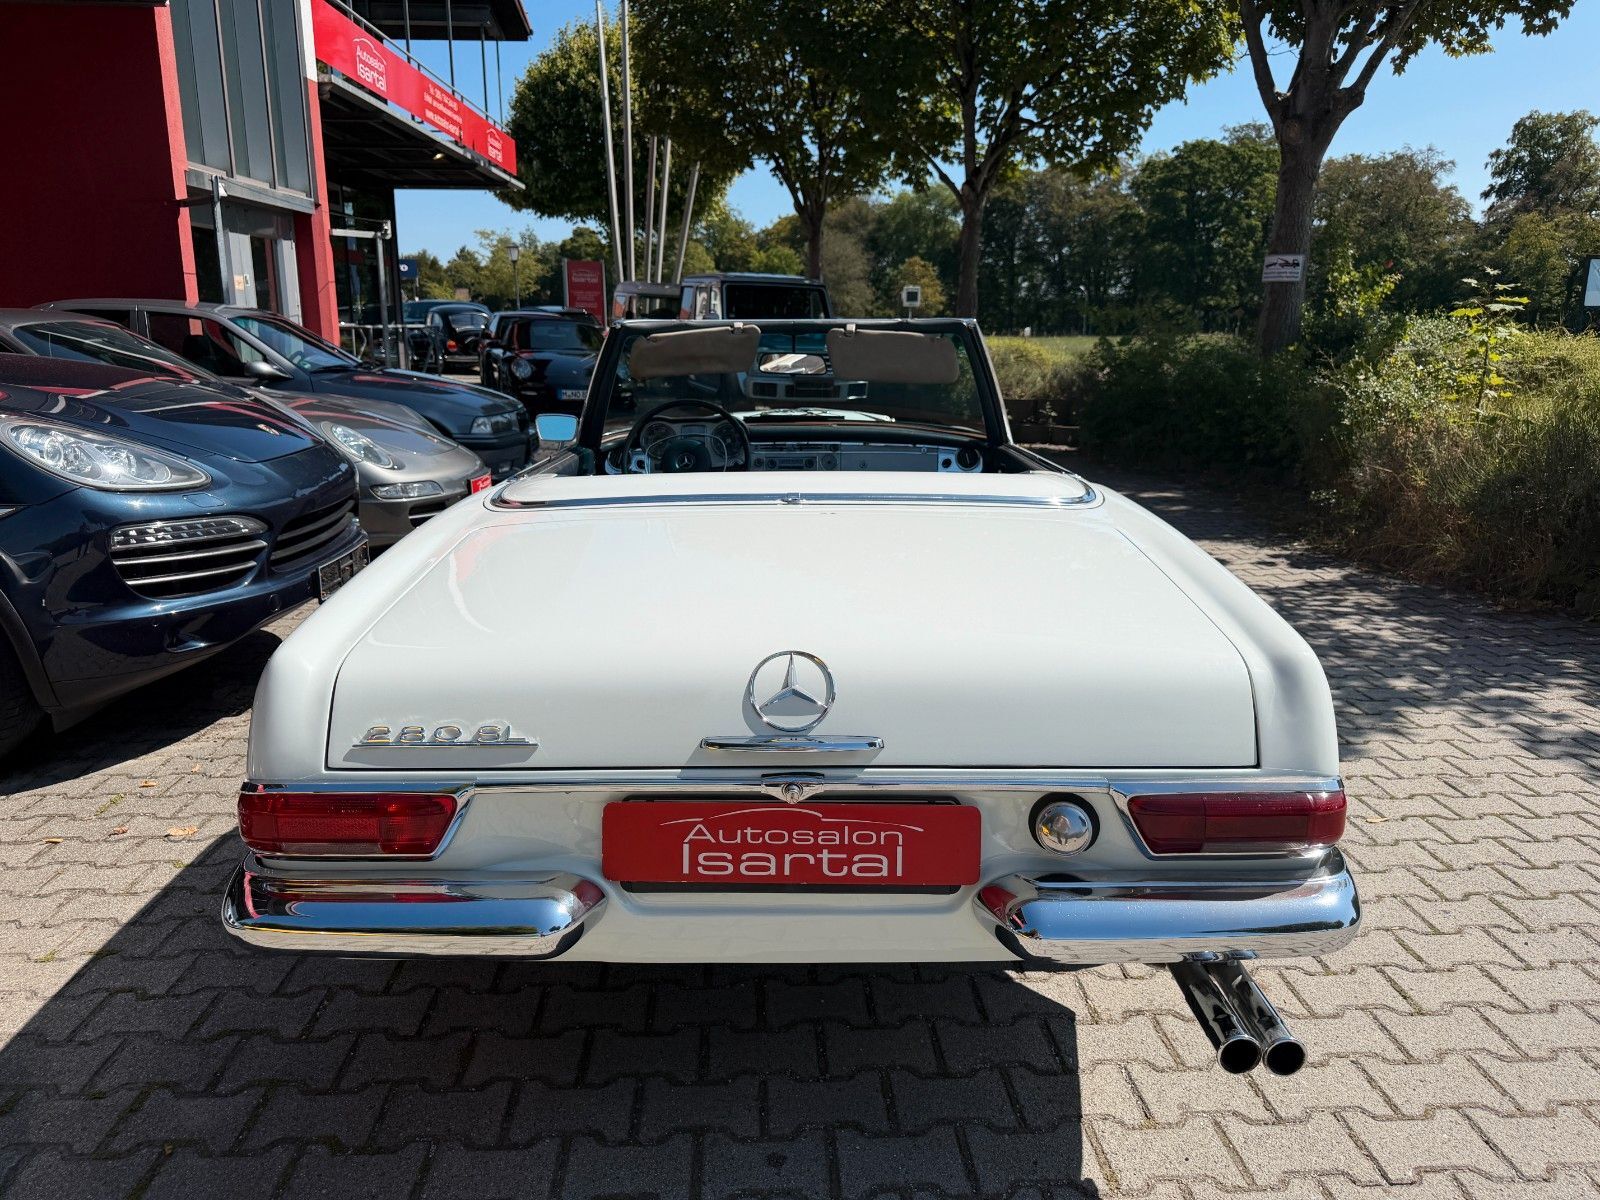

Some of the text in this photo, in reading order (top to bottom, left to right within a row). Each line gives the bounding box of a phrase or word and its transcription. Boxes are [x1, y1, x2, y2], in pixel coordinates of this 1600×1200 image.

[356, 44, 386, 71] Autosalon
[356, 55, 387, 92] Isartal
[366, 724, 527, 744] 280 SL
[683, 823, 904, 845] Autosalon
[682, 843, 904, 878] Isartal
